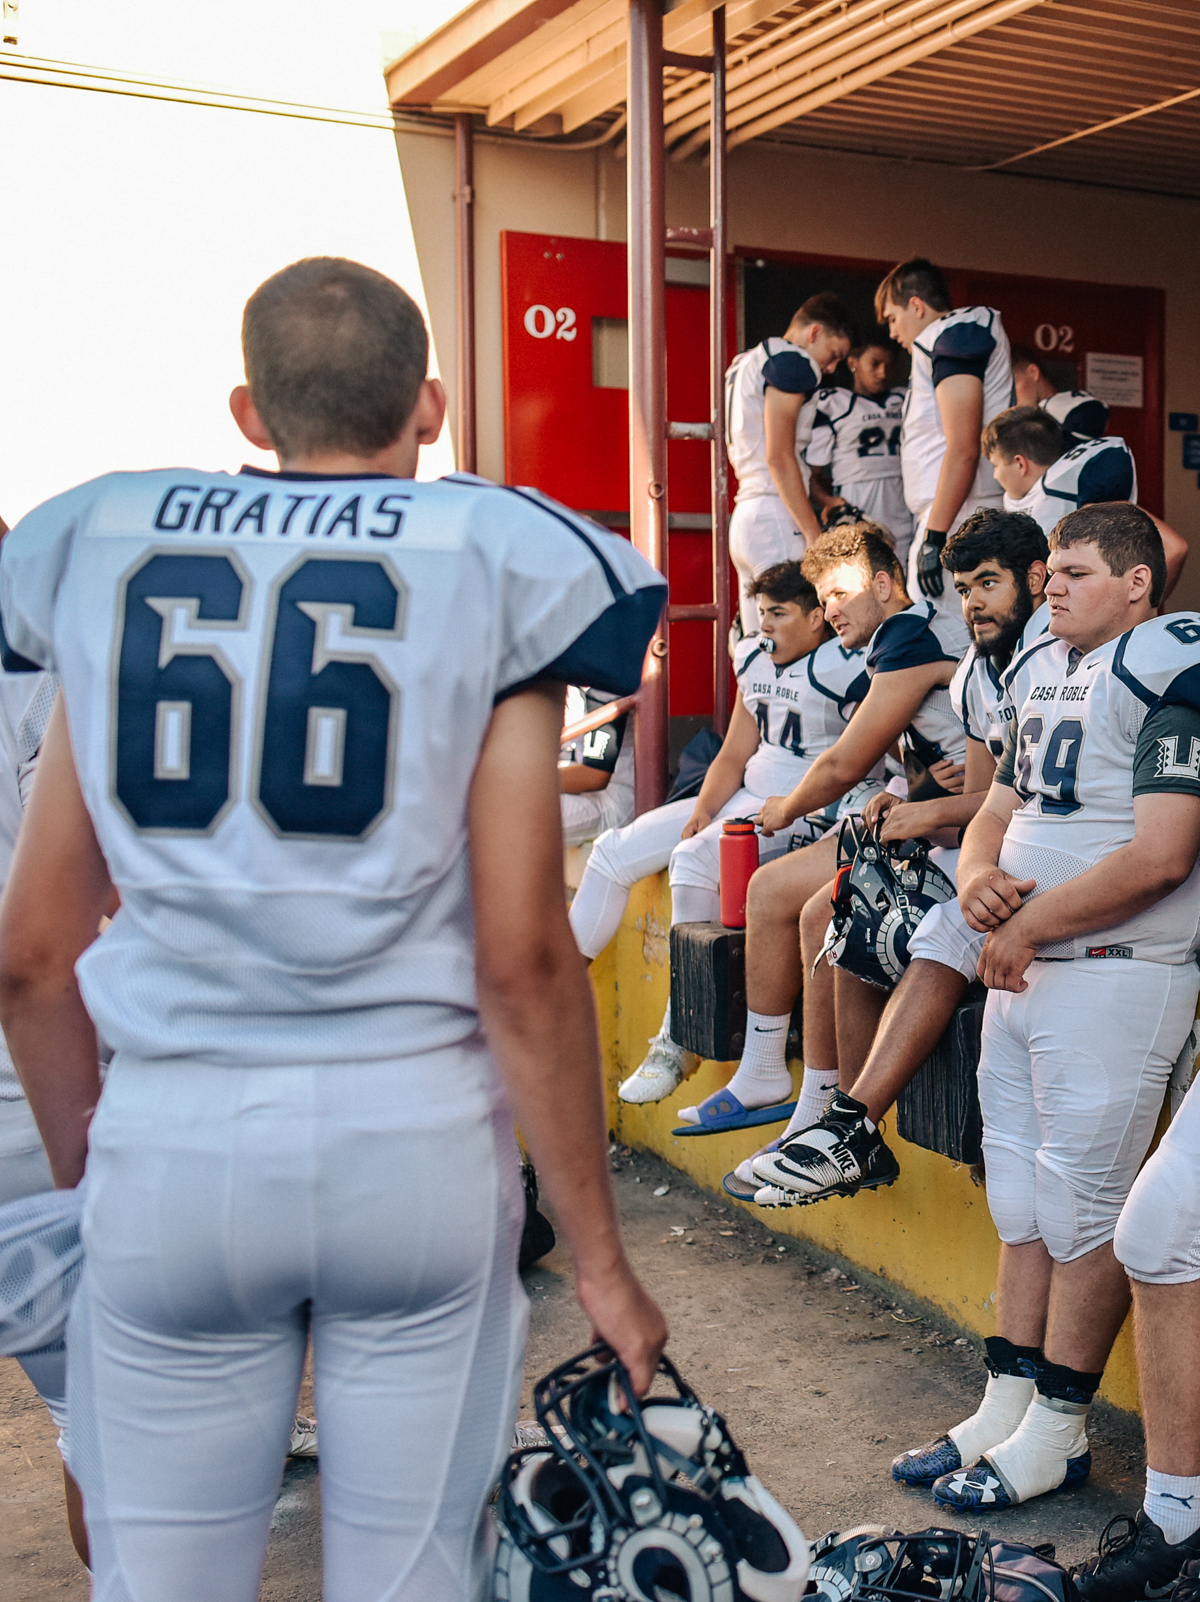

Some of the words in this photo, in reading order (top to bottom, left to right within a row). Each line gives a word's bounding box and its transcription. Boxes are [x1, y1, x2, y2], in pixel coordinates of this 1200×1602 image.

[154, 485, 412, 539] GRATIAS
[108, 545, 411, 842] 66
[752, 682, 771, 695] CASA
[776, 685, 799, 702] ROBLE
[1030, 686, 1056, 701] CASA
[1060, 685, 1090, 702] ROBLE
[1014, 713, 1087, 819] 69
[1108, 948, 1128, 957] XXL
[828, 1141, 856, 1175] NIKE
